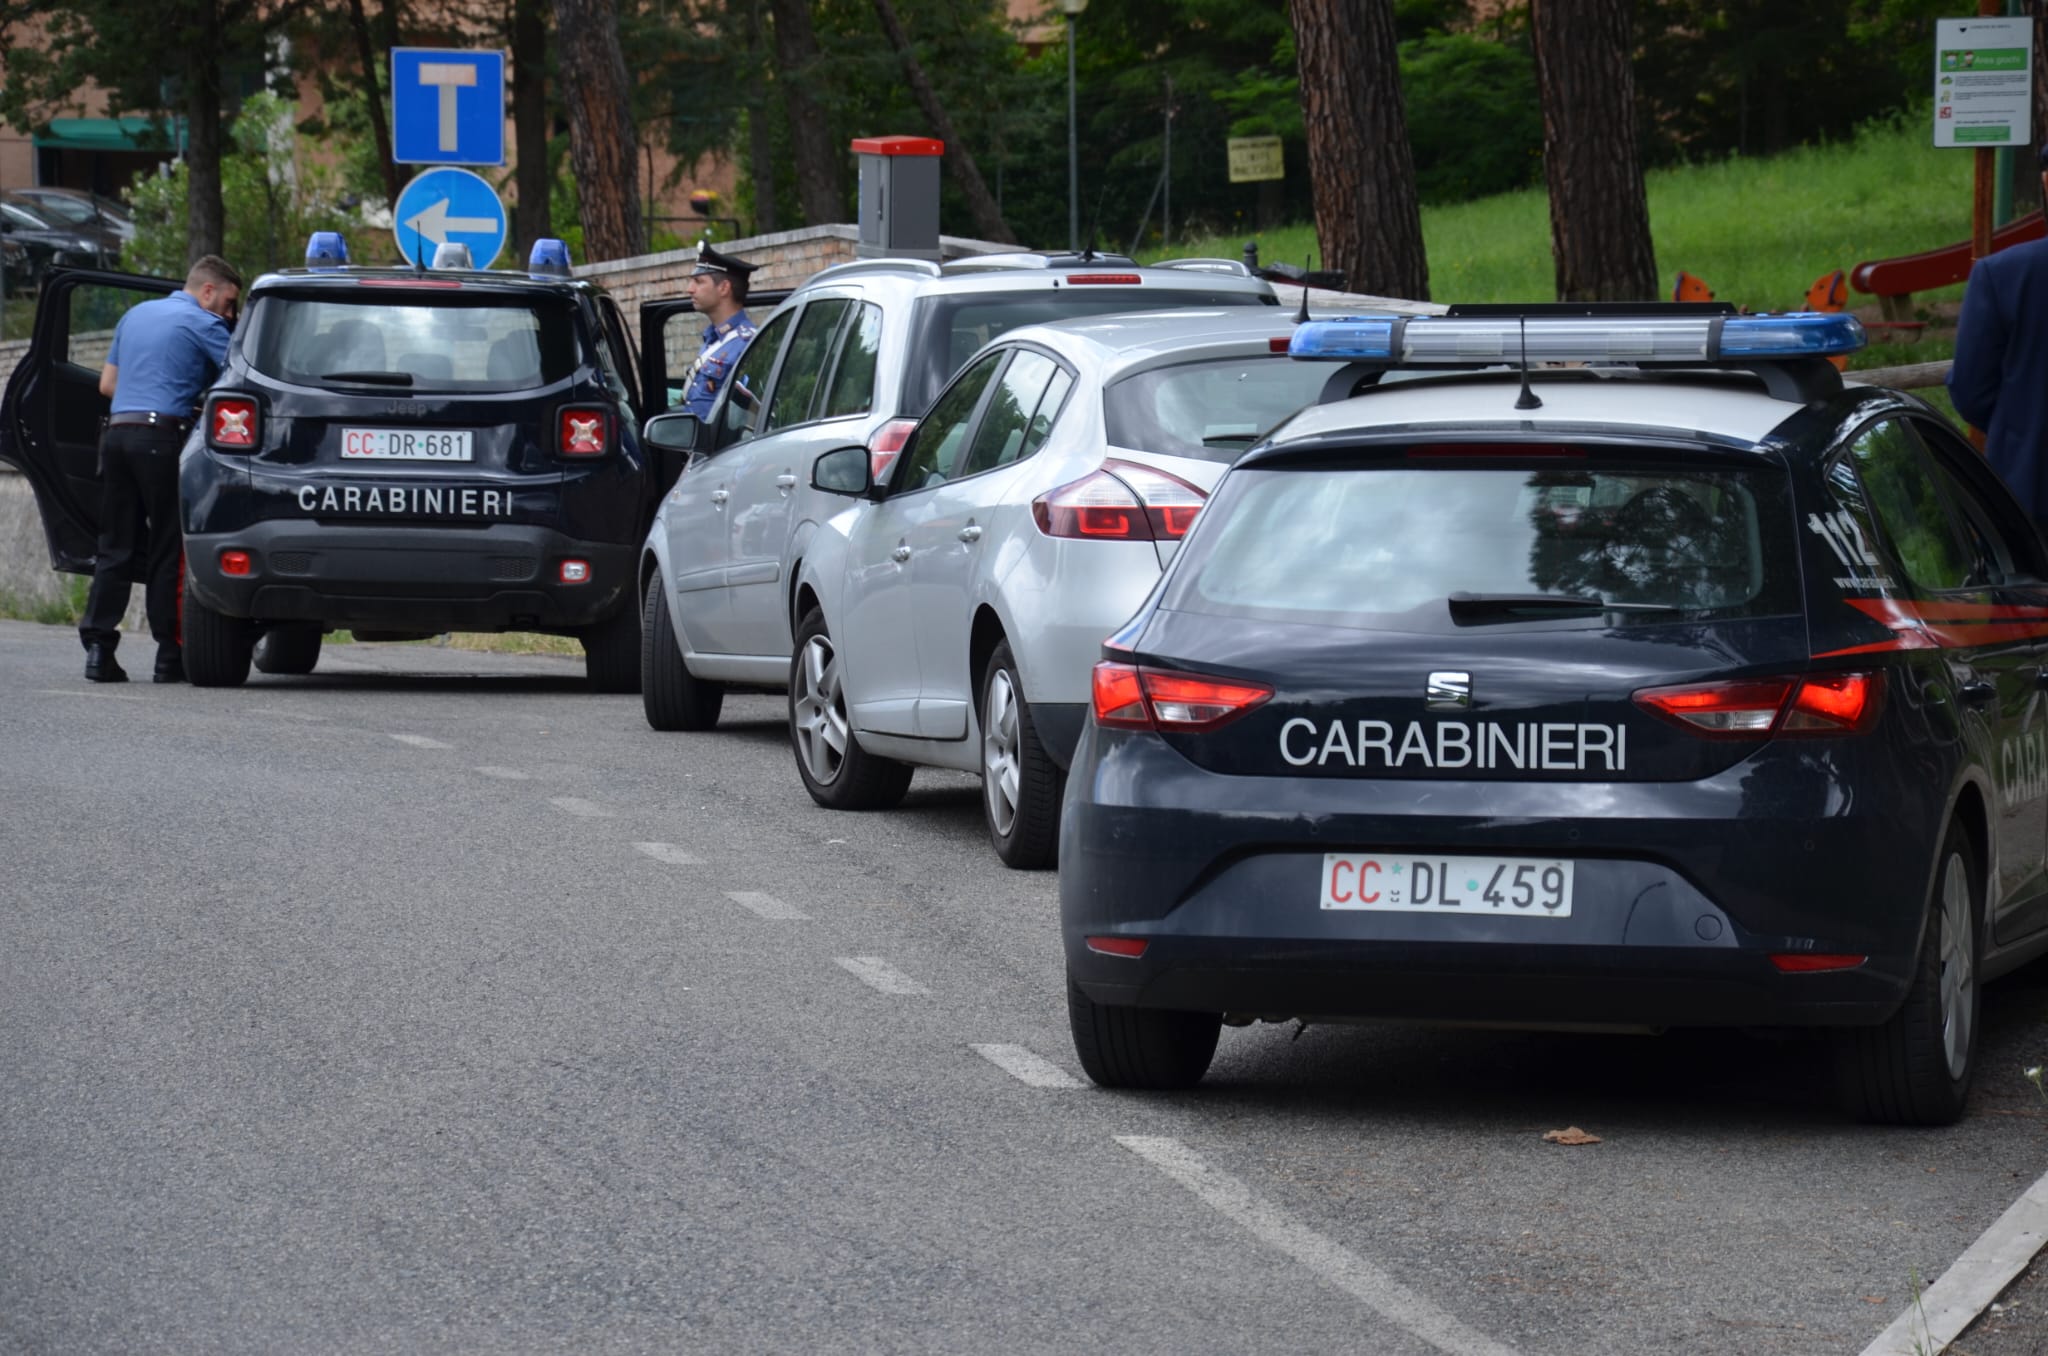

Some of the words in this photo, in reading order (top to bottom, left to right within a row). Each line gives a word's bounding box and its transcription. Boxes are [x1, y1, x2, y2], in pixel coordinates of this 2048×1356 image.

[387, 400, 427, 418] Jeep
[346, 432, 374, 455] CC
[389, 433, 416, 456] DR
[426, 435, 464, 458] 681
[299, 485, 513, 516] CARABINIERI
[1807, 511, 1880, 566] 112
[1279, 718, 1626, 770] CARABINIERI
[1330, 859, 1382, 904] CC
[1410, 861, 1461, 906] DL
[1482, 864, 1565, 910] 459
